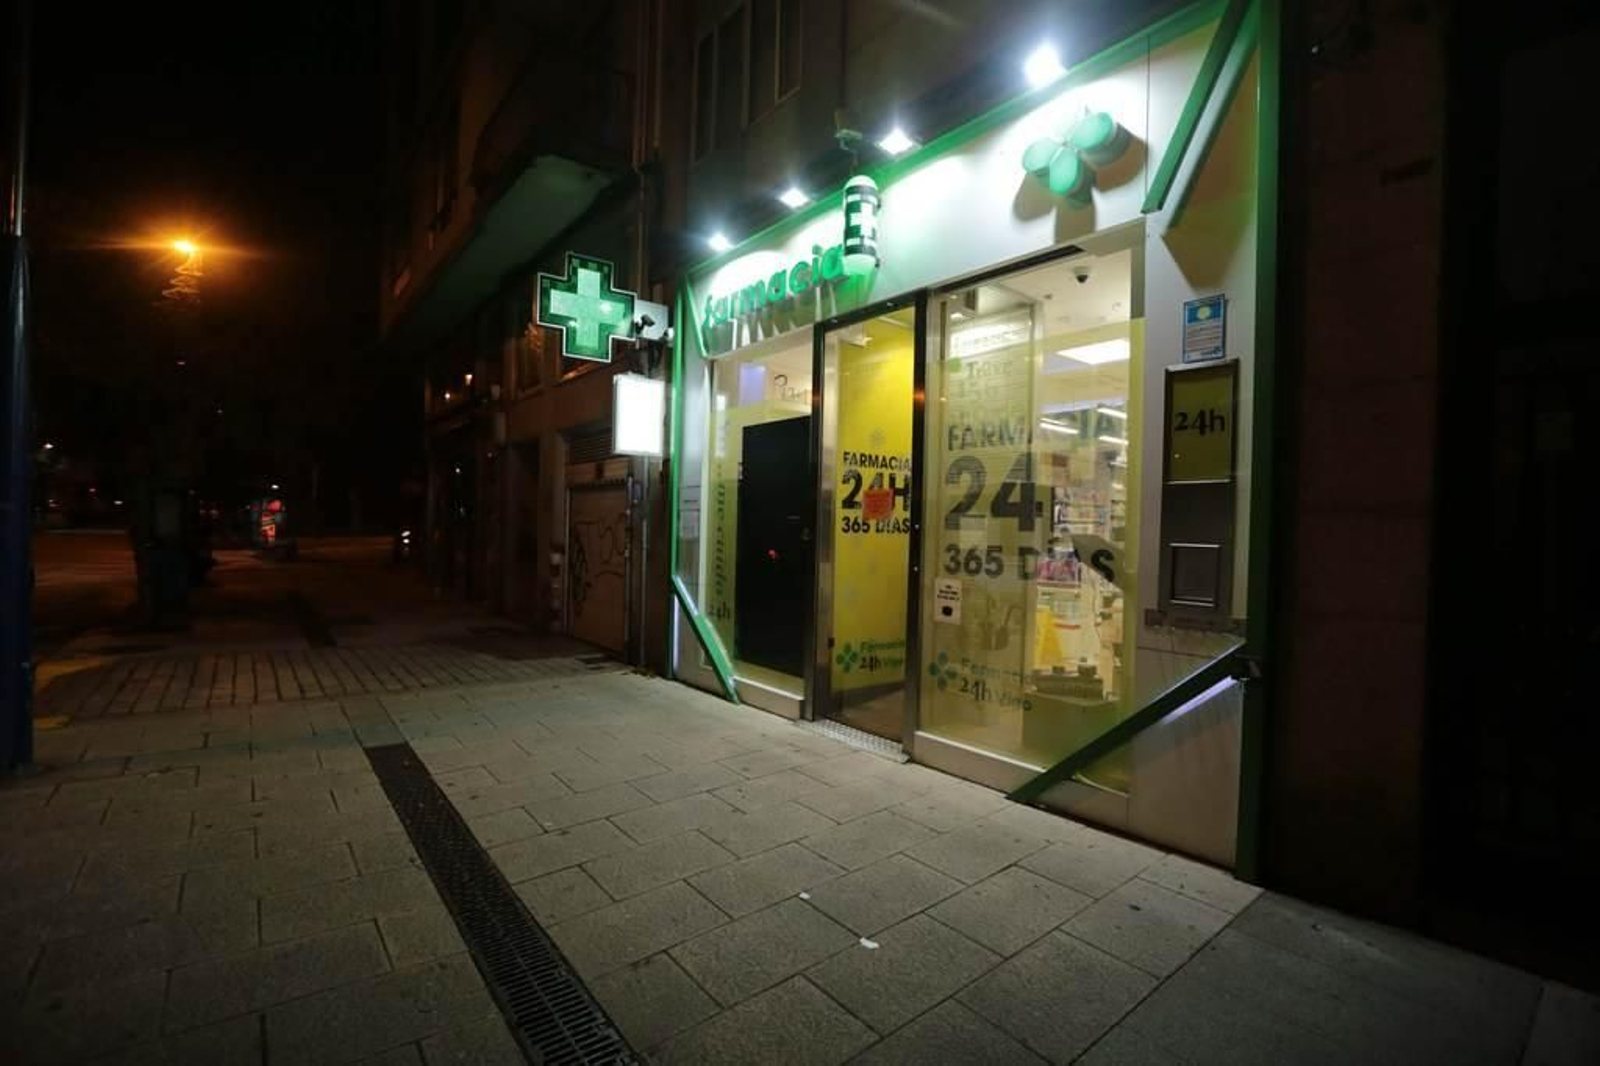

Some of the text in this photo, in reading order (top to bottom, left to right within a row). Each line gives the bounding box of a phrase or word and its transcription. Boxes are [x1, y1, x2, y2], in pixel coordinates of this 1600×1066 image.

[702, 243, 844, 326] farmacia
[1174, 408, 1226, 436] 24h
[842, 516, 871, 534] 365
[944, 543, 1005, 579] 365
[859, 654, 882, 673] 24h
[958, 676, 992, 701] 24h
